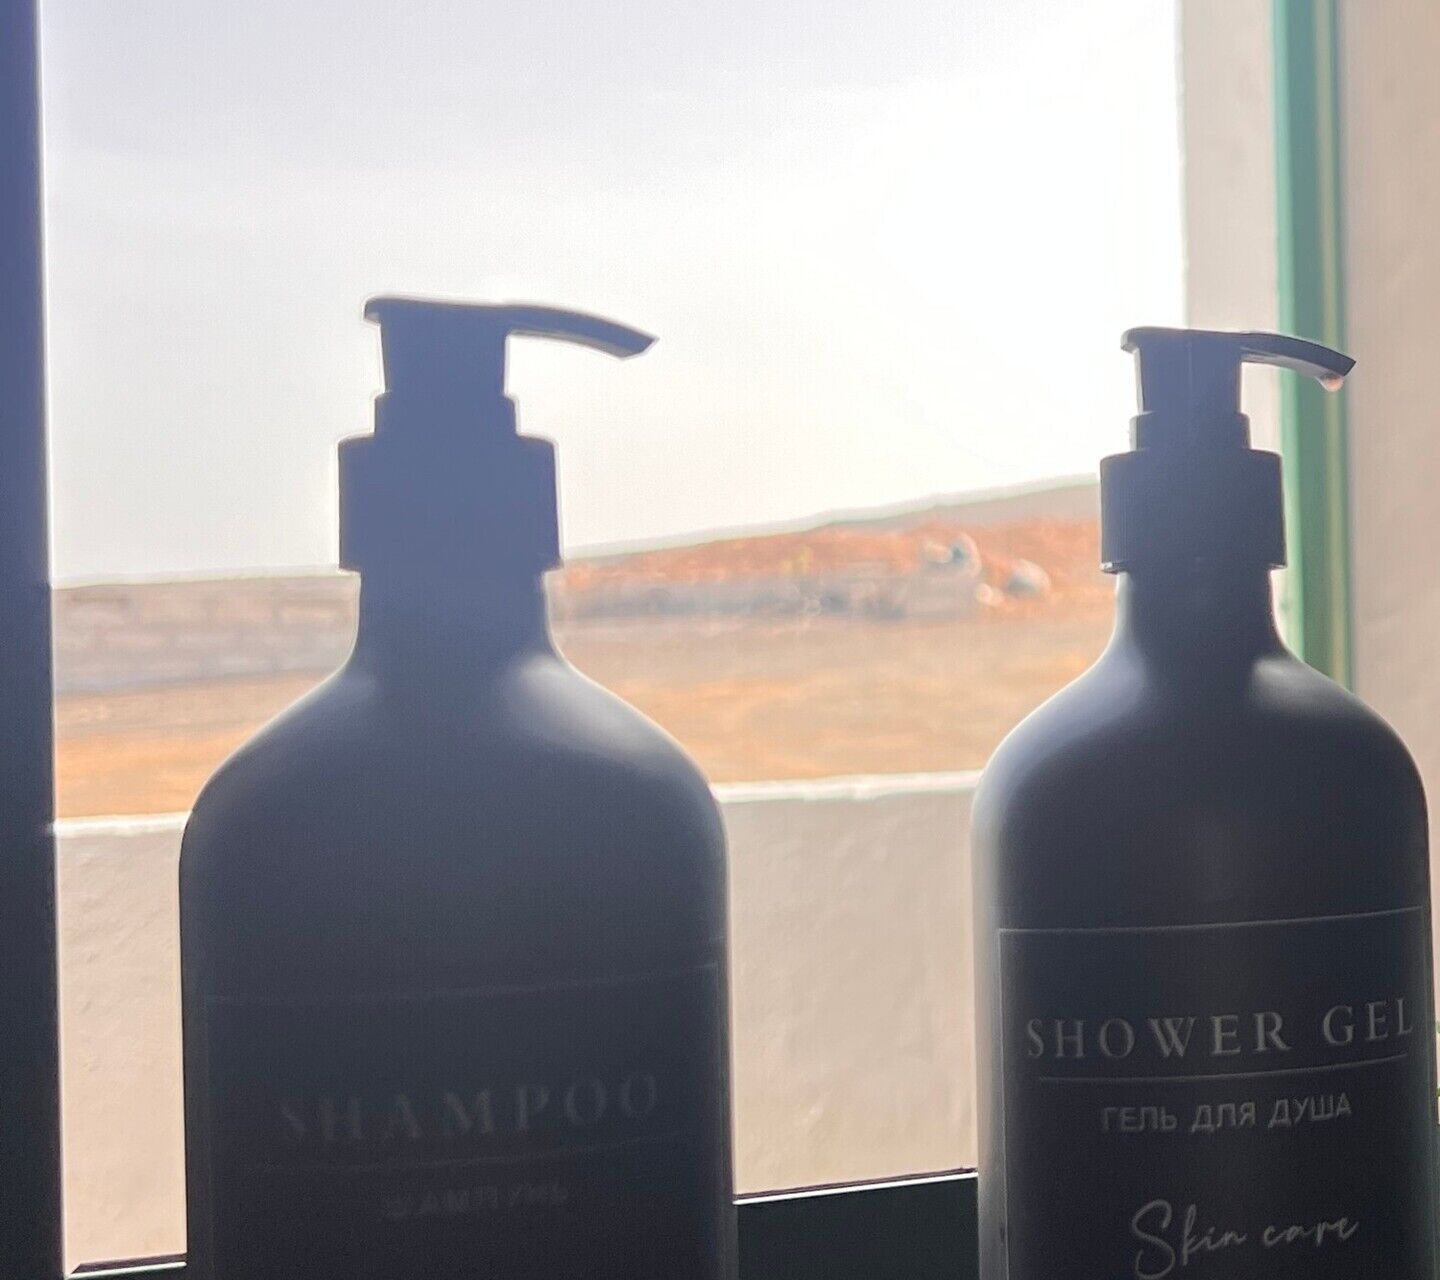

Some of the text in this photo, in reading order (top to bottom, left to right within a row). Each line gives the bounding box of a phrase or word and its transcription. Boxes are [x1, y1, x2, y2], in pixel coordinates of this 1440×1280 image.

[1026, 997, 1415, 1059] SHOWER GEL
[279, 1070, 659, 1143] SHAMPOO
[1100, 1091, 1353, 1135] ГЕЛЬ ДЛЯ ДУША
[1260, 1214, 1360, 1250] care
